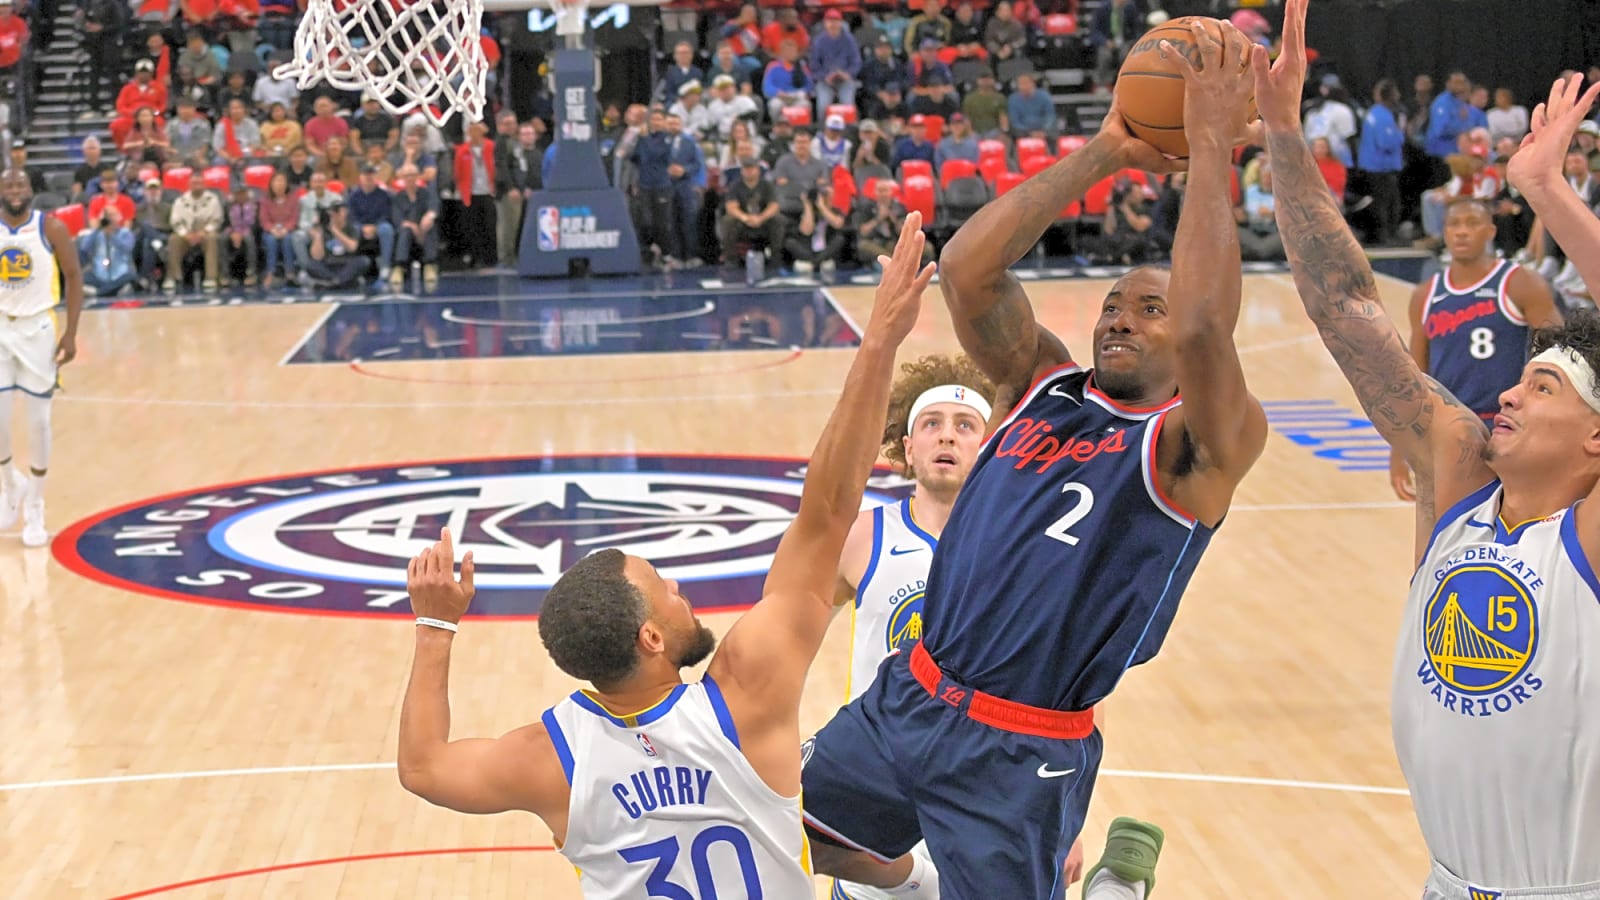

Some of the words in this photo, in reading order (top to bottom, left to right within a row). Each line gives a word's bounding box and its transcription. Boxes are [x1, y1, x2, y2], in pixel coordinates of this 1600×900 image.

[1469, 326, 1496, 360] 8
[995, 417, 1128, 475] Clippers
[114, 466, 451, 557] ANGELES
[1044, 481, 1095, 547] 2
[888, 579, 926, 605] GOLD
[1487, 595, 1519, 632] 15
[1416, 658, 1543, 718] WARRIORS
[611, 765, 713, 820] CURRY
[617, 825, 763, 900] 30
